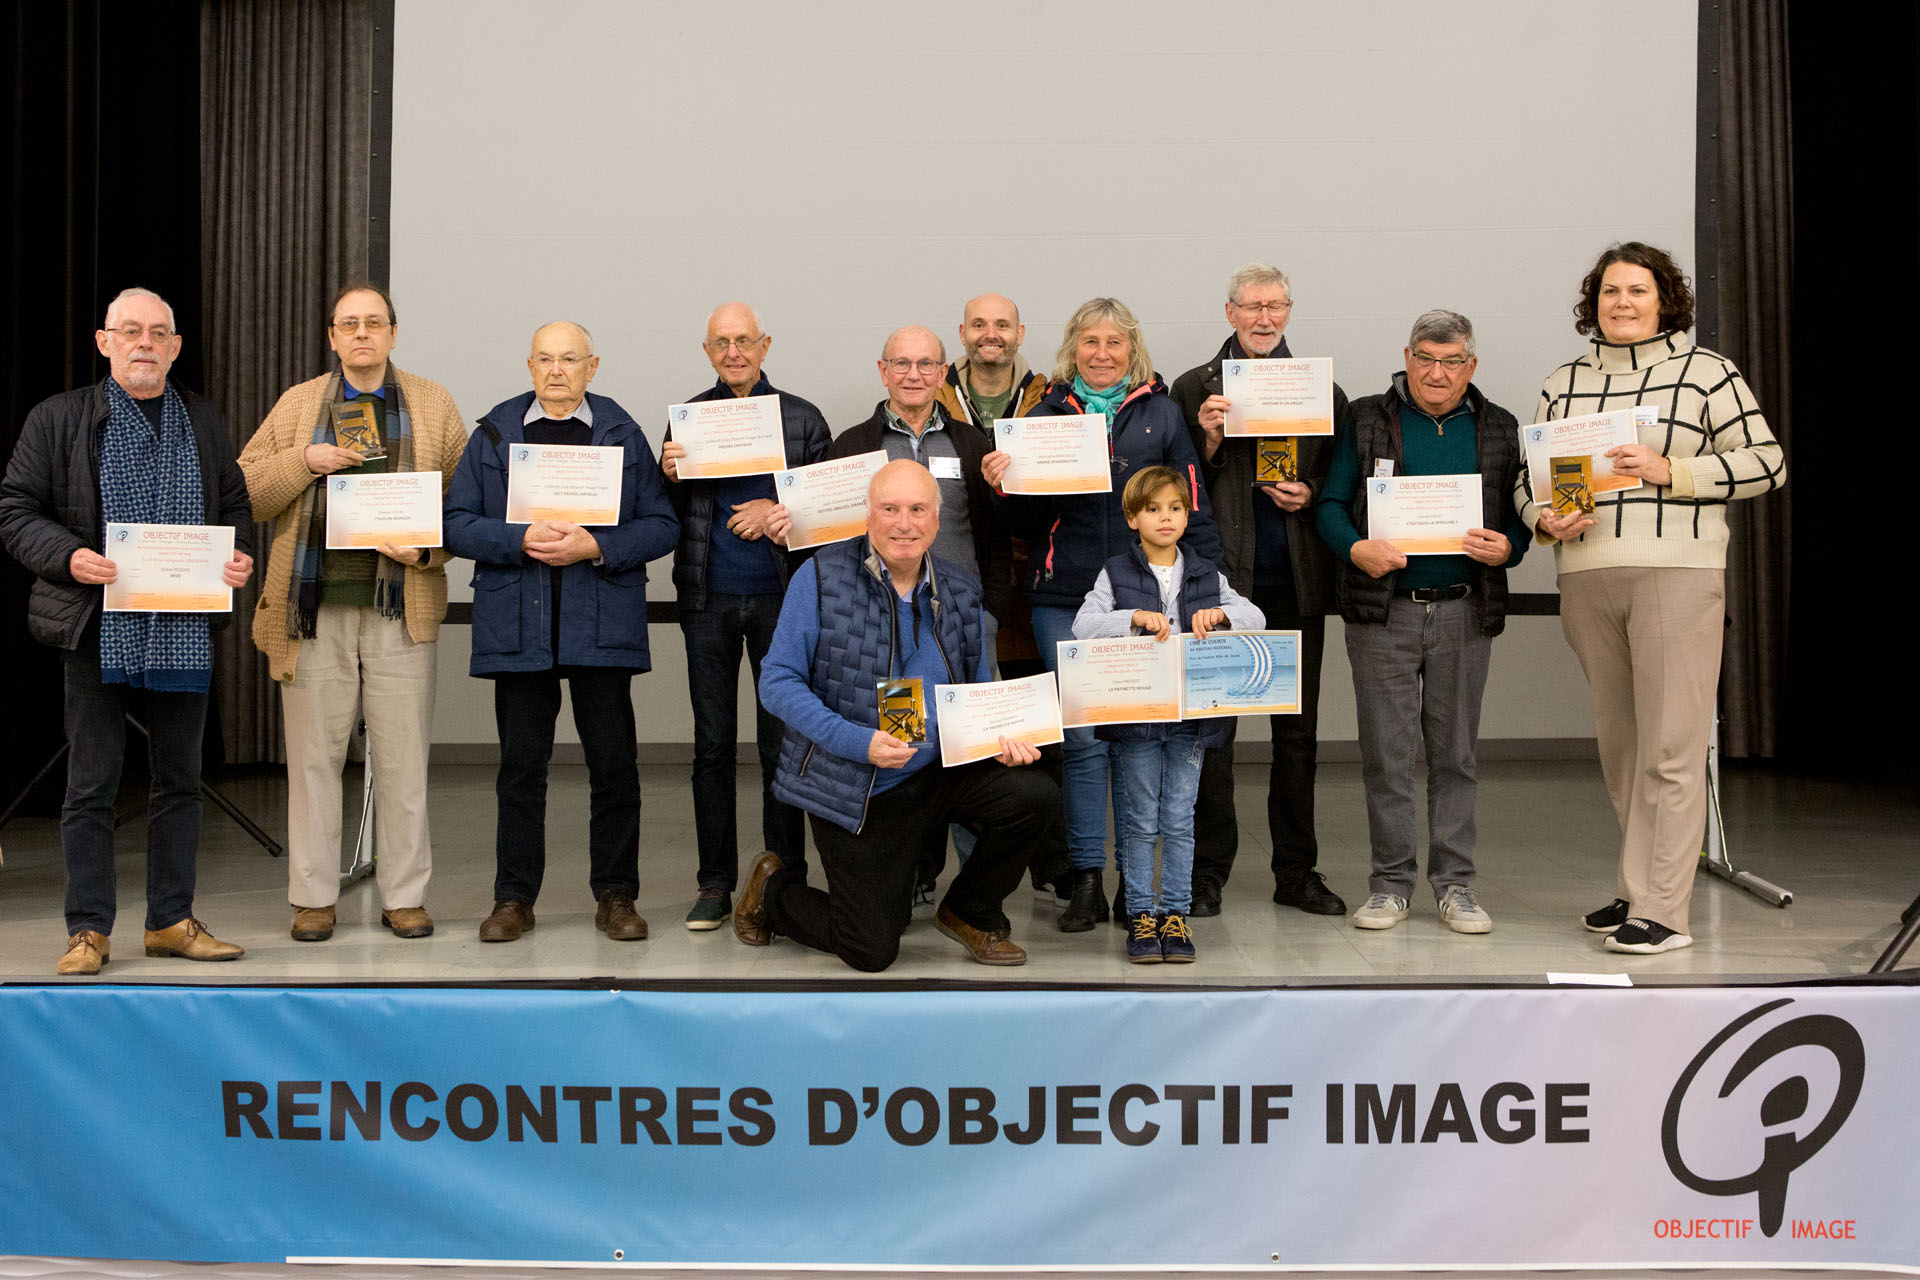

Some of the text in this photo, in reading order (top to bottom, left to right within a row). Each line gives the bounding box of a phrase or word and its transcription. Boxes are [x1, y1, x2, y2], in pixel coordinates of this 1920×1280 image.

[736, 403, 758, 412] IMAGE
[1554, 419, 1612, 434] OBJECTIF IMAGE
[807, 468, 841, 479] OBJECTIF
[842, 461, 865, 471] IMAGE
[1092, 643, 1155, 654] OBJECTIF IMAGE
[969, 683, 1032, 698] OBJECTIF IMAGE
[221, 1080, 1591, 1146] RENCONTRES D'OBJECTIF IMAGE
[1654, 1219, 1856, 1240] OBJECTIF IMAGE
